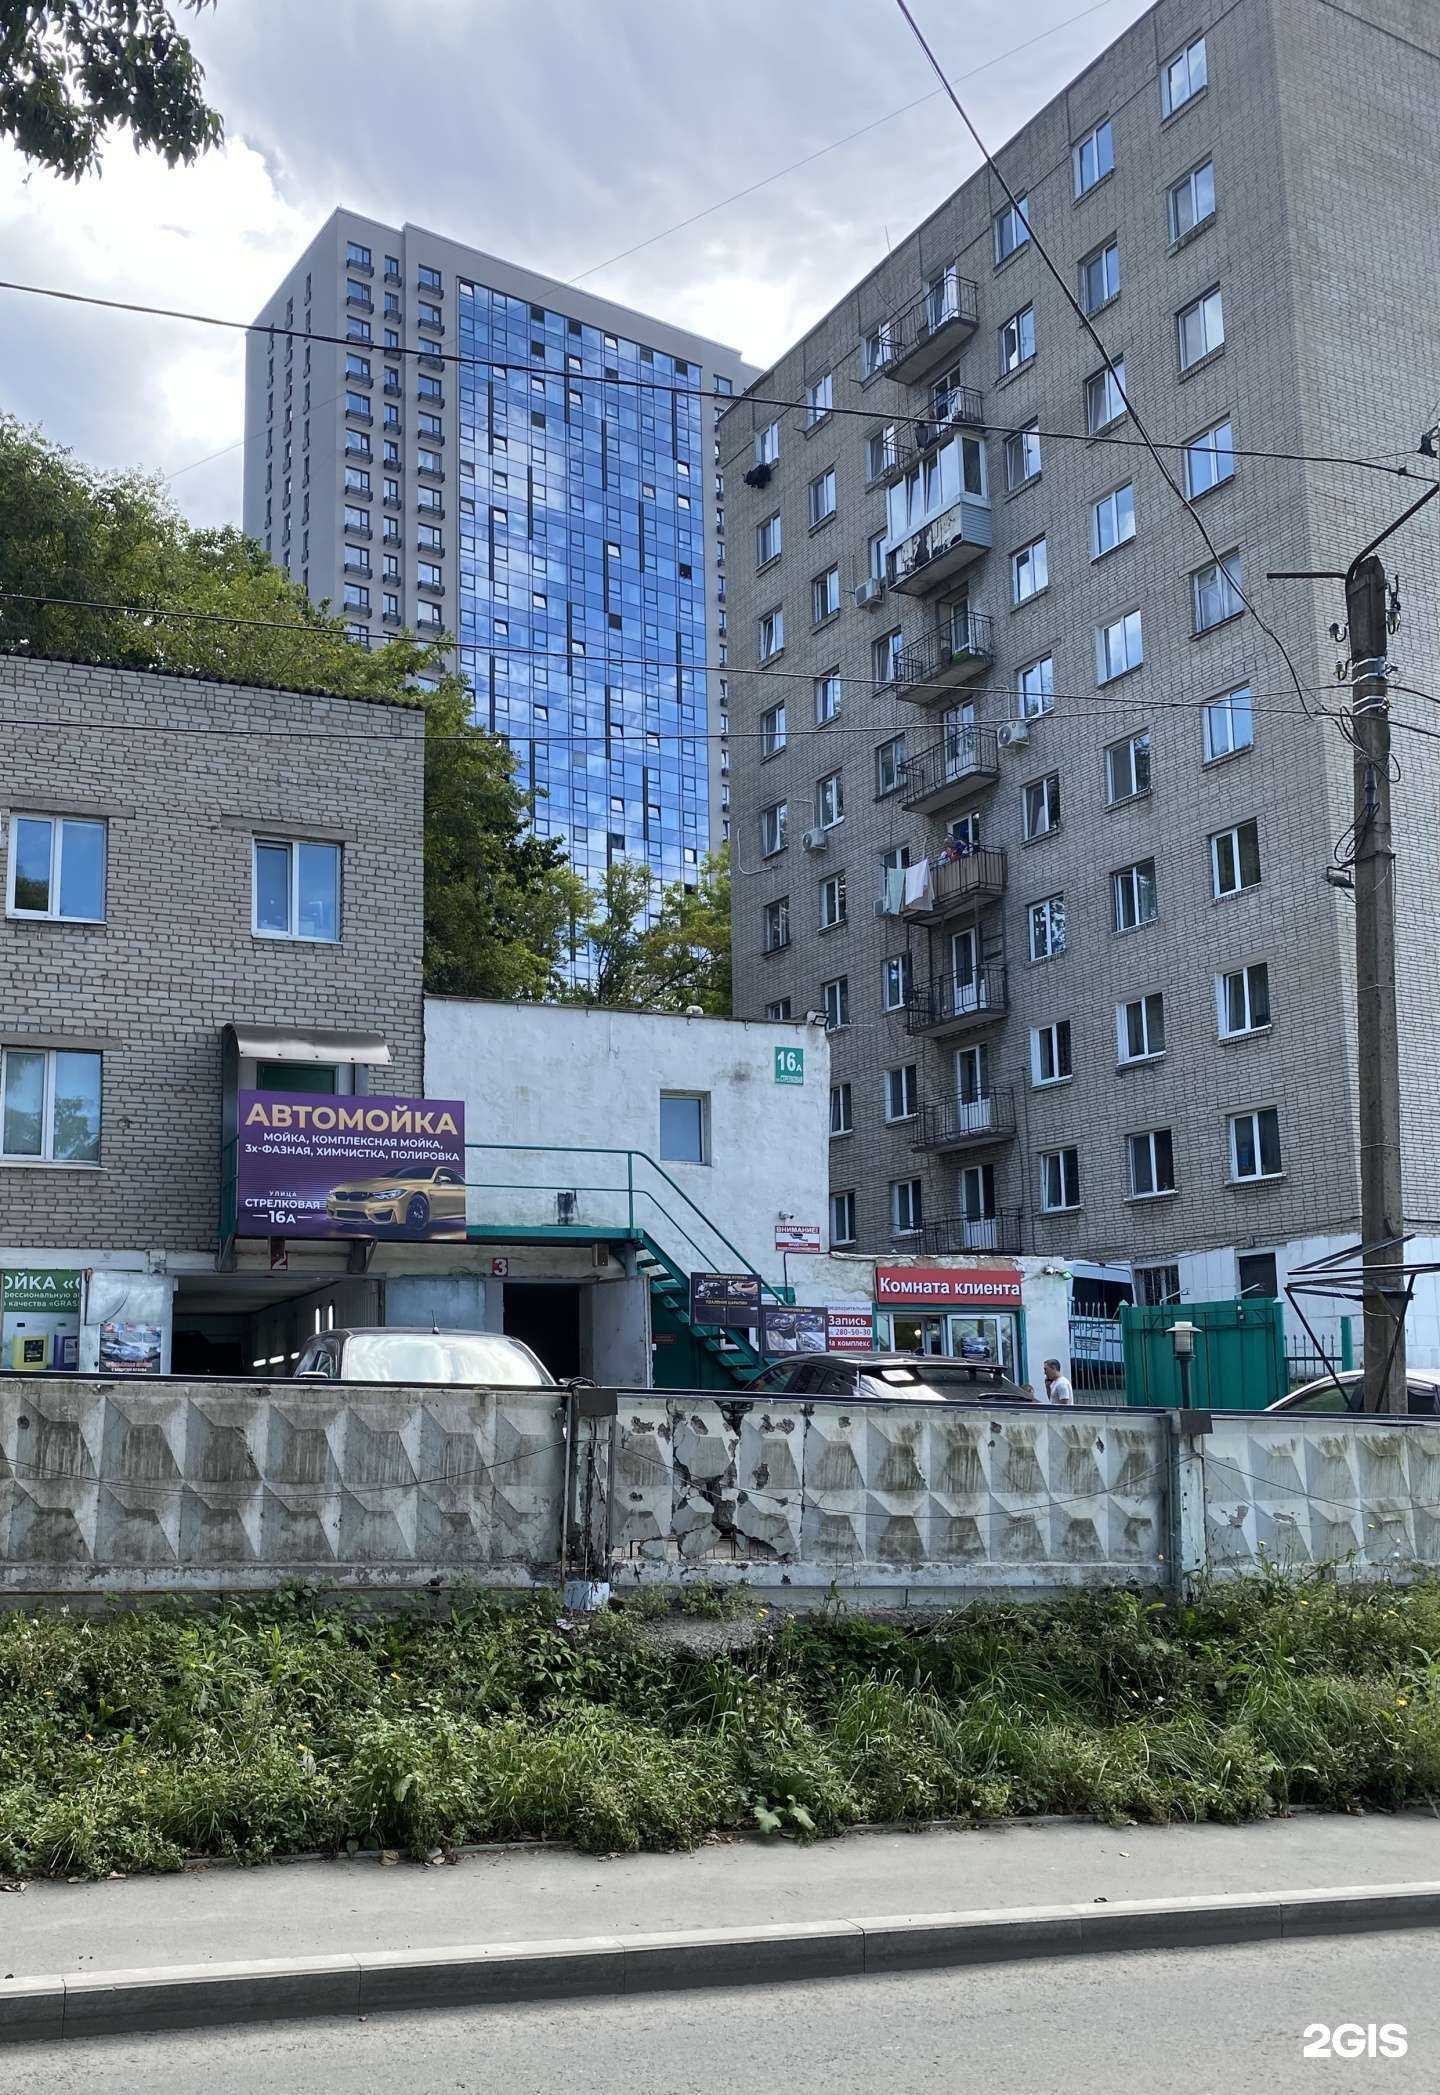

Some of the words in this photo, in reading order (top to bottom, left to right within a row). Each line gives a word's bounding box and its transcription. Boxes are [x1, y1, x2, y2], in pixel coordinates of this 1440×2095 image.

[245, 1103, 458, 1135] АВТОМОЙКА
[263, 1132, 309, 1144] МОЙКА,
[312, 1135, 397, 1147] КОМПЛЕКСНАЯ
[400, 1138, 443, 1150] МОЙКА,
[245, 1144, 313, 1156] 3х-ФАЗНАЯ,
[316, 1147, 388, 1159] ХИМЧИСТКА,
[391, 1150, 459, 1161] ПОЛИРОВКА
[269, 1190, 297, 1198] УЛИЦА
[245, 1198, 320, 1209] СТРЕЛКОВАЯ
[776, 1226, 819, 1234] ВНИМАНИЕ!
[494, 1258, 508, 1276] 3
[880, 1277, 950, 1294] Комната
[955, 1282, 1021, 1295] клиента
[828, 1315, 867, 1326] Запись
